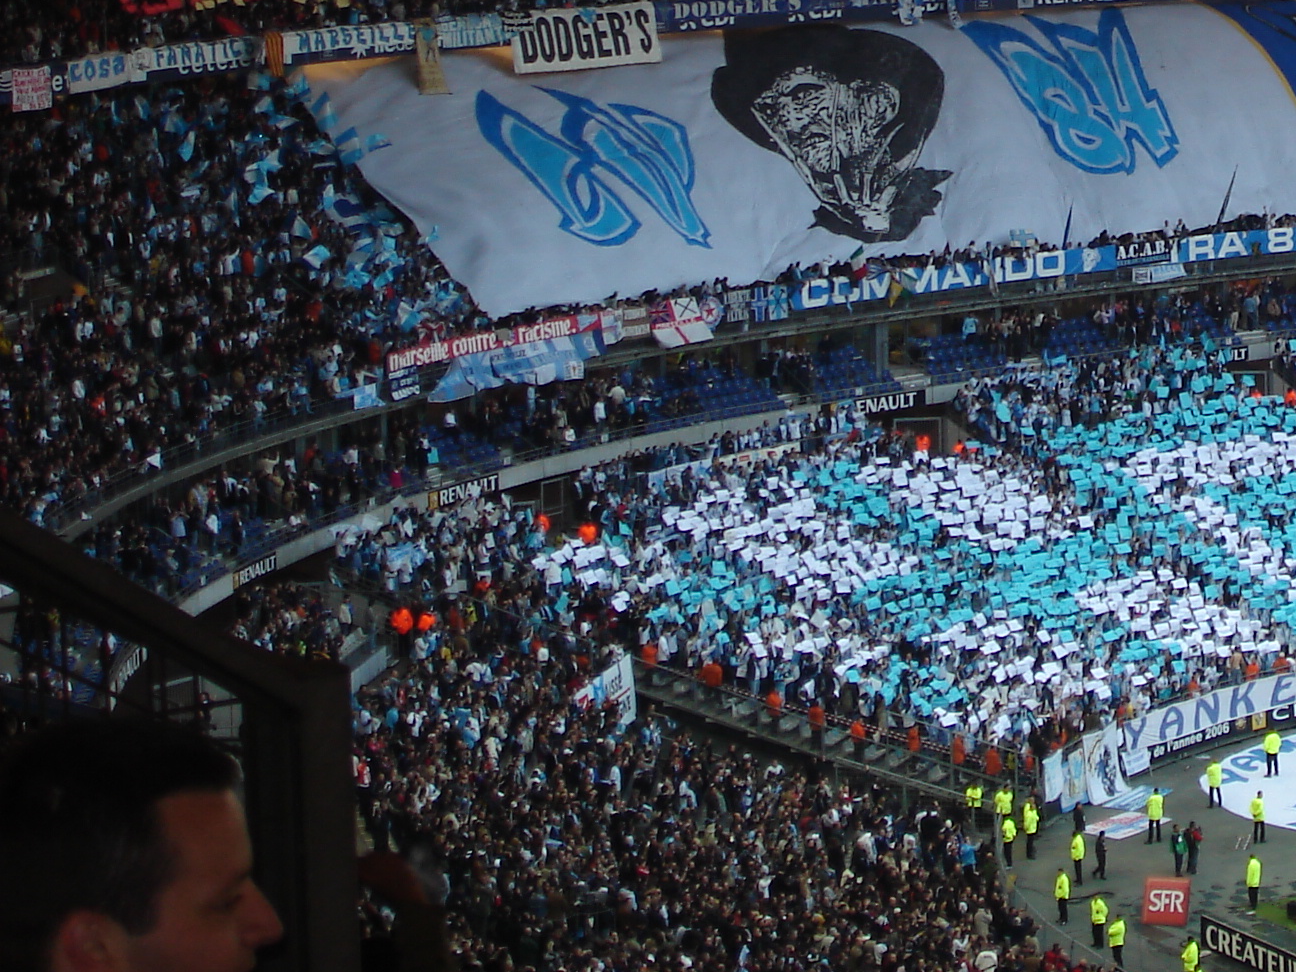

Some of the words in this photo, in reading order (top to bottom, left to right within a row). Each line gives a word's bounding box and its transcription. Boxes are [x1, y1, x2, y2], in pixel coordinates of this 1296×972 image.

[298, 22, 415, 53] MARSEILLE
[519, 9, 653, 64] DODGER'S
[1117, 240, 1169, 260] A.C.A.B.
[388, 342, 449, 371] marseille
[452, 331, 497, 359] contre
[519, 317, 577, 343] racisme.
[855, 392, 917, 414] ENAULT
[239, 555, 276, 580] RENAULT
[1153, 744, 1166, 759] de
[1167, 731, 1203, 754] l'année
[1205, 723, 1230, 742] 2006
[1149, 889, 1185, 913] SFR
